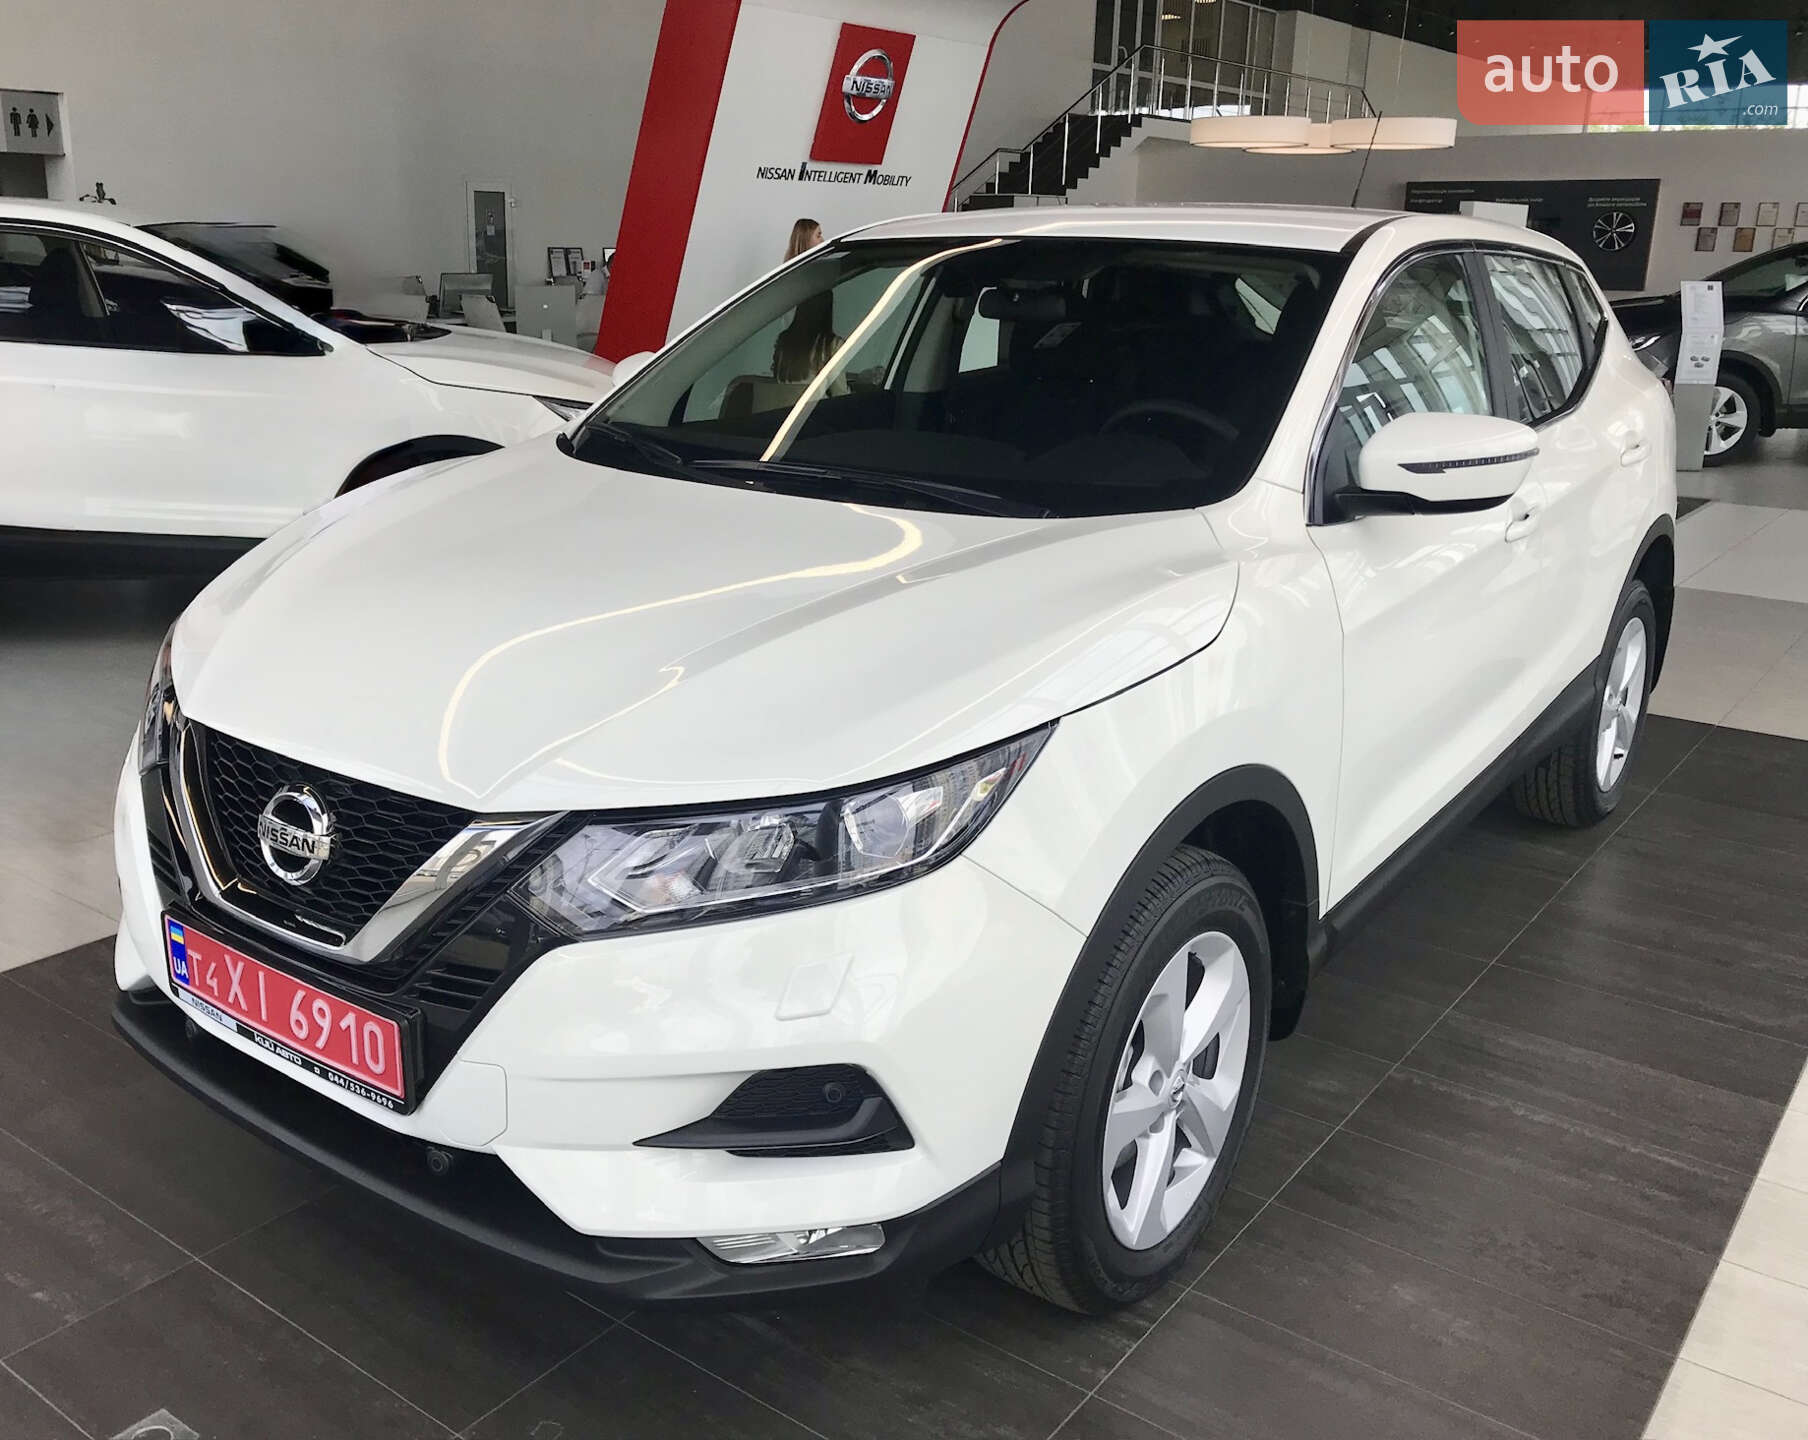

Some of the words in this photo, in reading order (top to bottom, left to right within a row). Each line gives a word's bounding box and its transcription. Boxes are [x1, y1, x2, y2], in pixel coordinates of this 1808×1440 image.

[850, 79, 893, 97] NISSAN
[756, 166, 796, 181] NISSAN
[259, 820, 316, 855] NISSAN
[173, 956, 189, 979] UA
[191, 997, 223, 1022] NISSAN
[289, 989, 385, 1077] 6910
